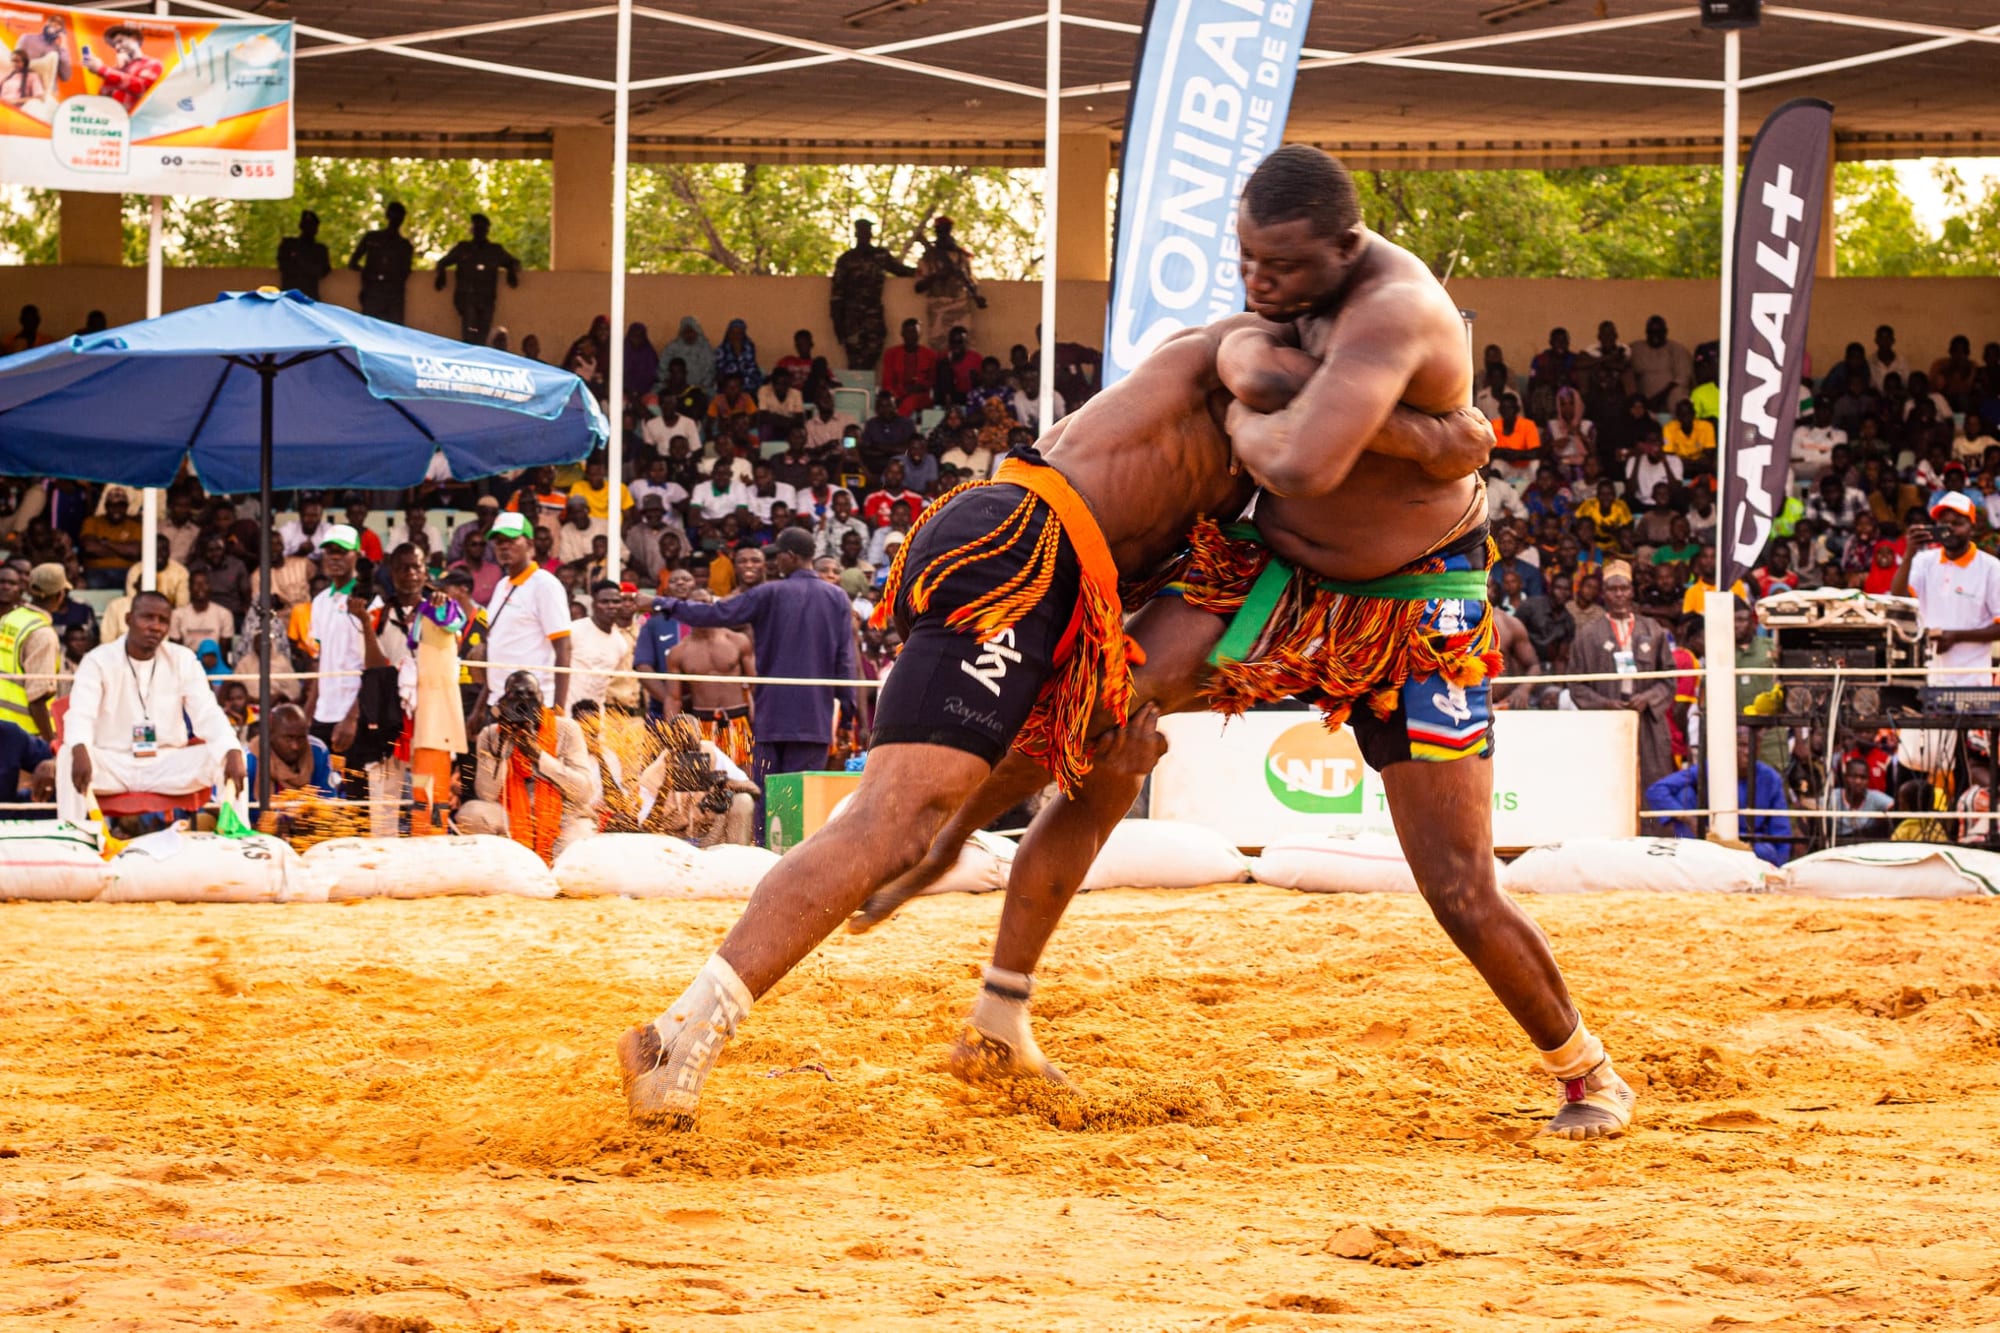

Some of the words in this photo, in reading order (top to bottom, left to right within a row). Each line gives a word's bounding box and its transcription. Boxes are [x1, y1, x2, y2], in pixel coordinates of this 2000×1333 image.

[1256, 36, 1288, 88] DE
[244, 165, 274, 178] 555
[1732, 164, 1804, 568] CANAL+
[1286, 758, 1356, 792] NT
